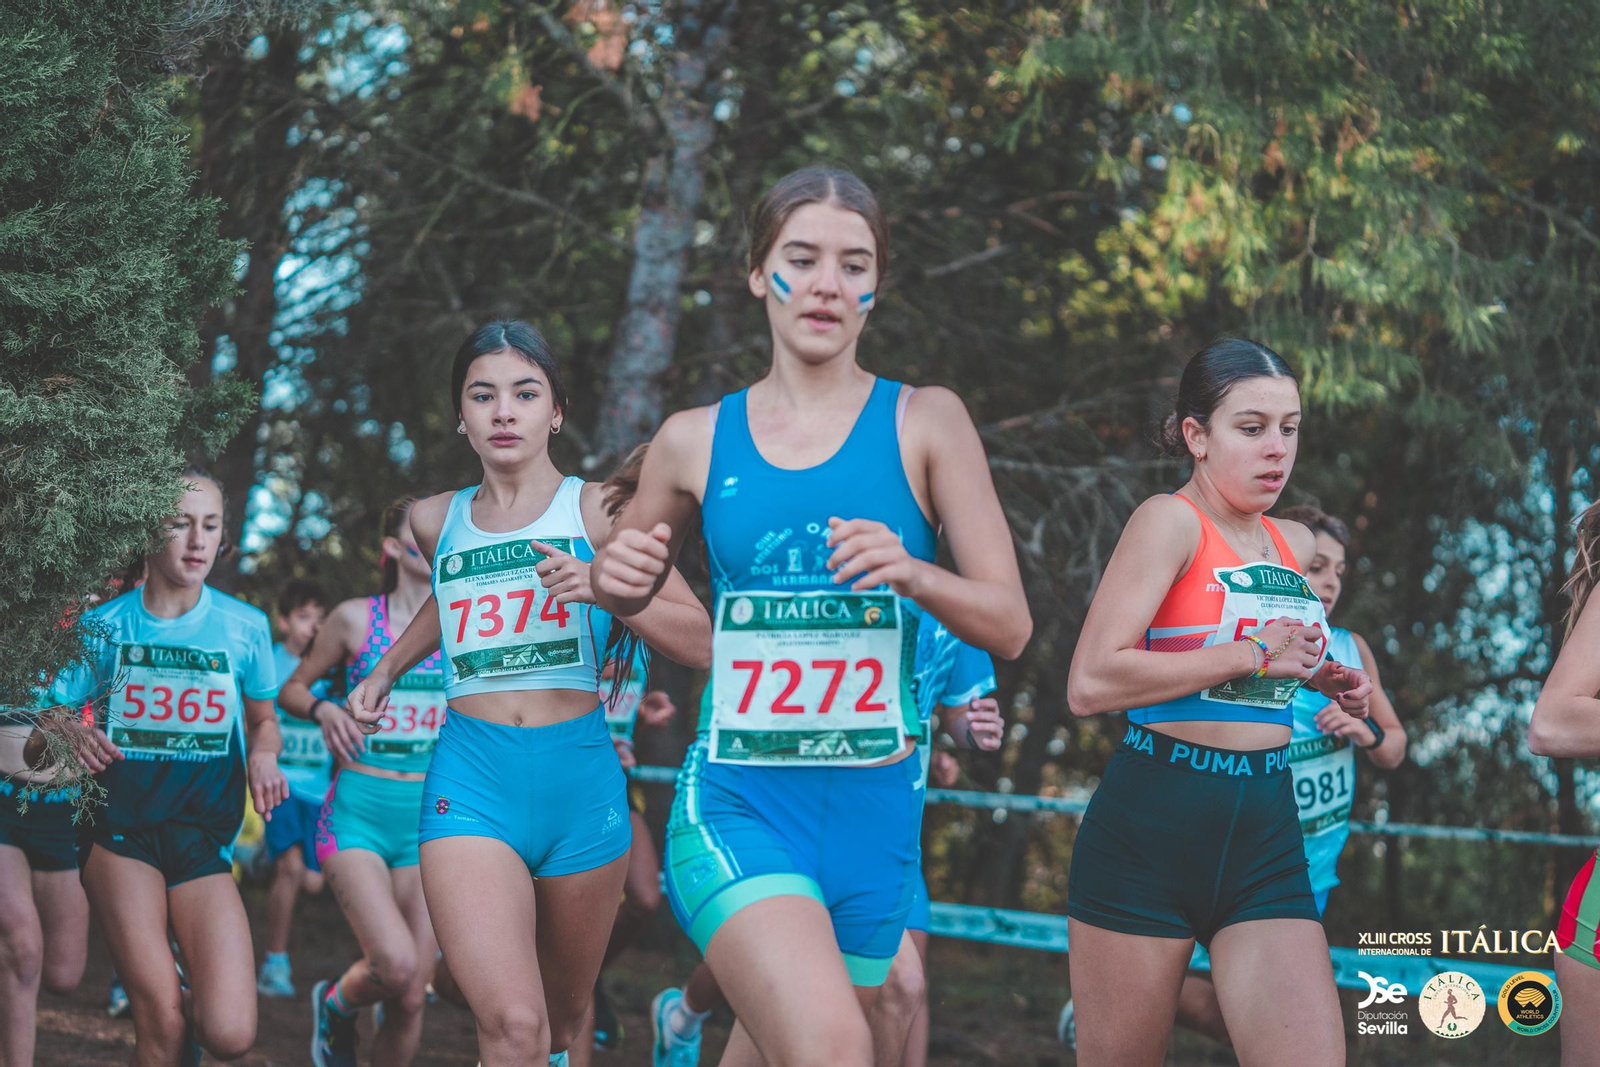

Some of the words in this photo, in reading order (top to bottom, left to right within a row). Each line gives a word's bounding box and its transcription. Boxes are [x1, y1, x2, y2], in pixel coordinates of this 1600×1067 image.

[465, 574, 484, 583] ELENA
[1259, 567, 1301, 589] ITÁLICA
[449, 588, 571, 644] 7374
[122, 684, 226, 724] 5365
[732, 657, 887, 714] 7272
[1169, 743, 1253, 776] PUMA
[1296, 765, 1349, 810] 981
